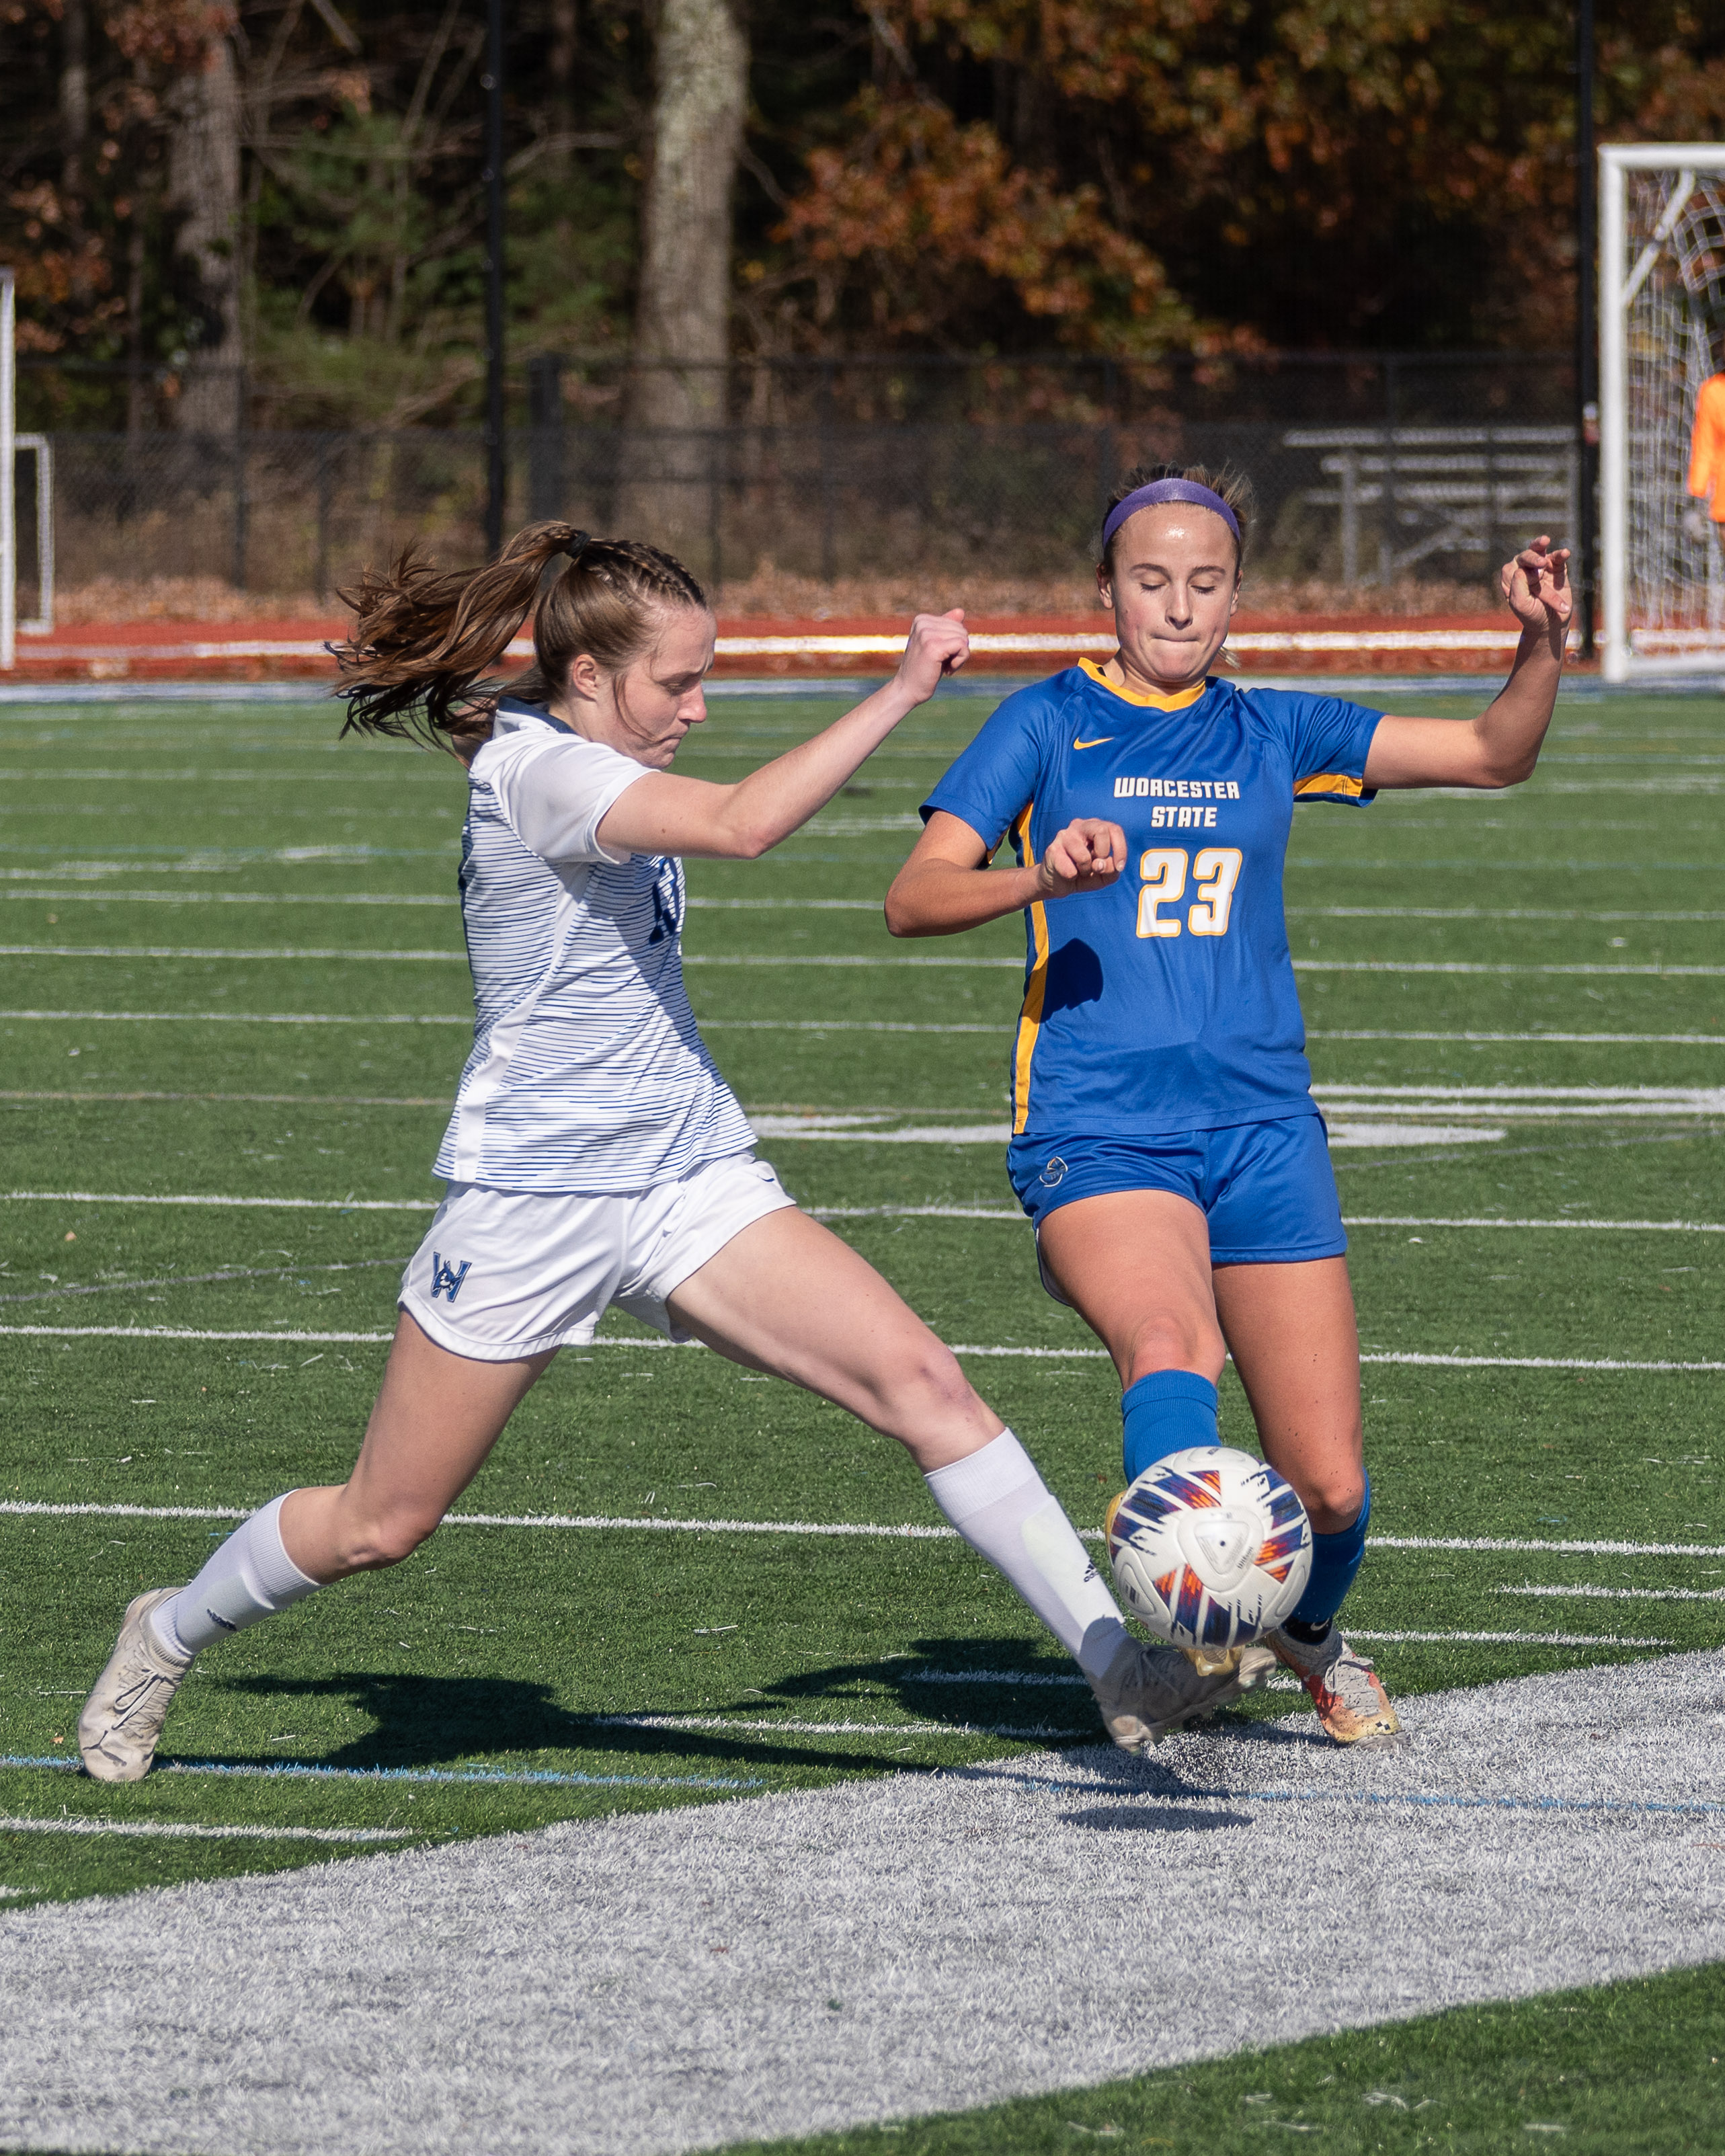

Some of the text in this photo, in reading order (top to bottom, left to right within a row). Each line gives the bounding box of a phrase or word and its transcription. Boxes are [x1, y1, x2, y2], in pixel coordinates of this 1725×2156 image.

[1113, 777, 1240, 799] WORCESTER
[1150, 805, 1218, 828] STATE
[1136, 847, 1243, 939] 23
